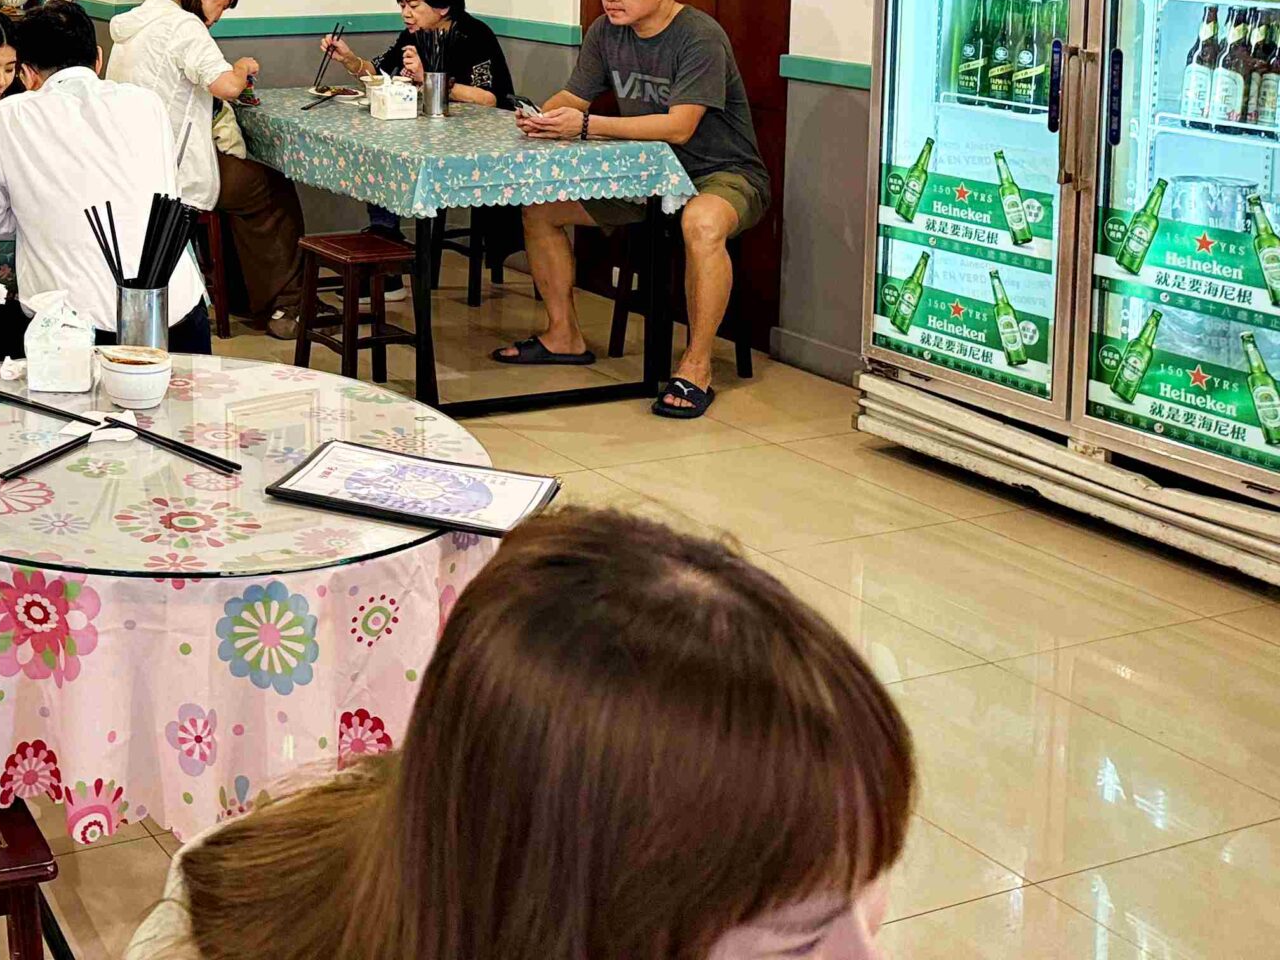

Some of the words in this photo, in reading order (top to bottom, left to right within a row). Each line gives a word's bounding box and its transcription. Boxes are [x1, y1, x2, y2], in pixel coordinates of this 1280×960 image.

[932, 184, 951, 195] 150
[973, 192, 993, 203] YRS
[932, 201, 992, 224] Heineken
[925, 218, 1000, 245] 就是要海尼根
[1220, 241, 1246, 256] YRS
[1165, 251, 1244, 280] Heineken
[1155, 271, 1253, 305] 就是要海尼根
[928, 298, 946, 310] 150
[968, 309, 988, 322] YRS
[927, 314, 987, 342] Heineken
[920, 332, 993, 364] 就是要海尼根
[1160, 363, 1184, 378] 150
[1213, 377, 1239, 392] YRS
[1159, 382, 1237, 417] Heineken
[1149, 401, 1247, 441] 就是要海尼根
